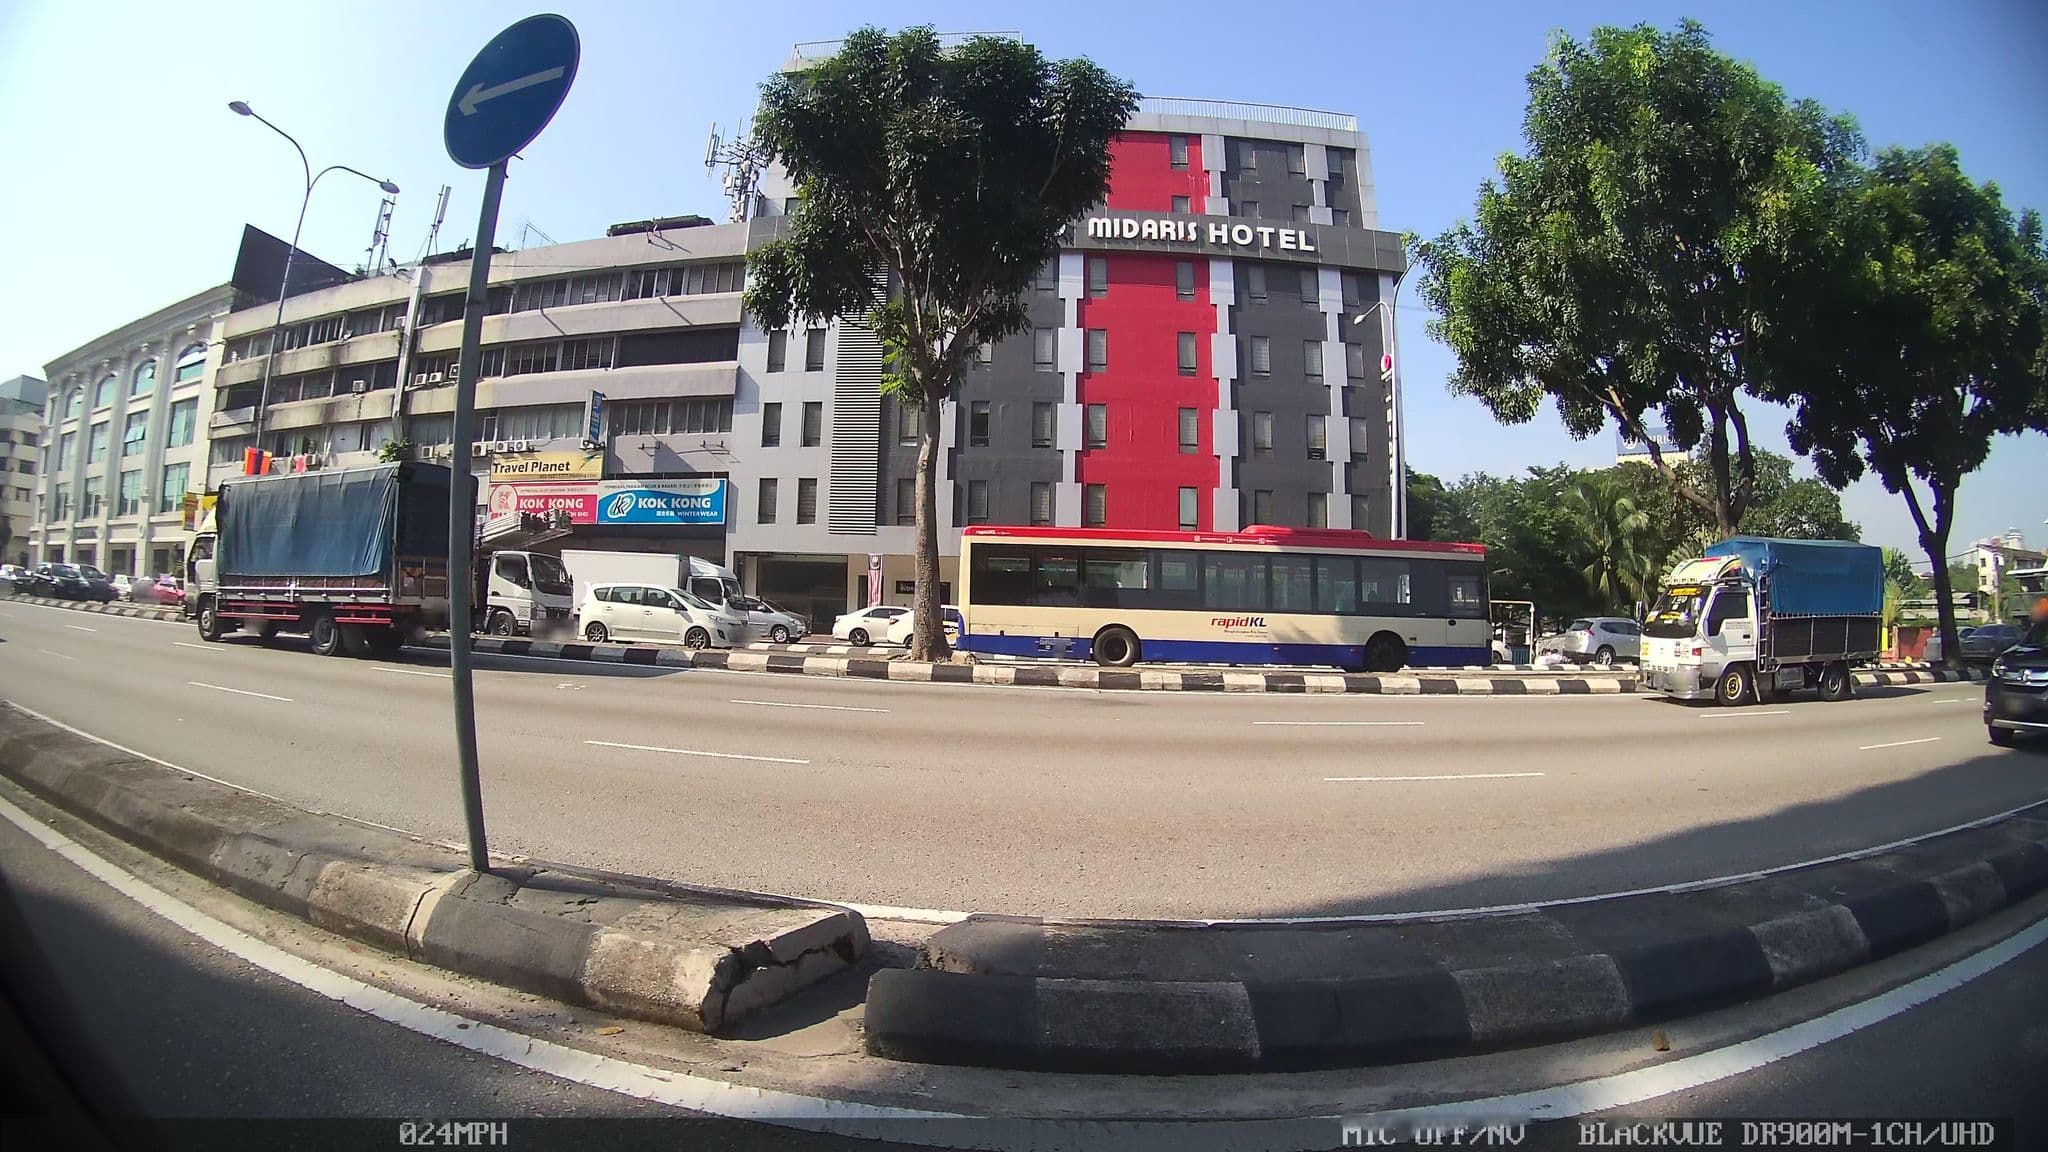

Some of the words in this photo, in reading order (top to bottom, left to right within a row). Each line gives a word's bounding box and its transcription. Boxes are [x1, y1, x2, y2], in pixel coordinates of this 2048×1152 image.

[1088, 218, 1197, 242] MIDARIS
[1209, 222, 1315, 252] HOTEL
[493, 461, 528, 474] Travel
[531, 461, 570, 473] Planet
[519, 498, 543, 509] KOK
[548, 498, 584, 509] KONG
[638, 497, 667, 509] KOK
[671, 497, 711, 509] KONG
[1210, 616, 1267, 629] rapidKL
